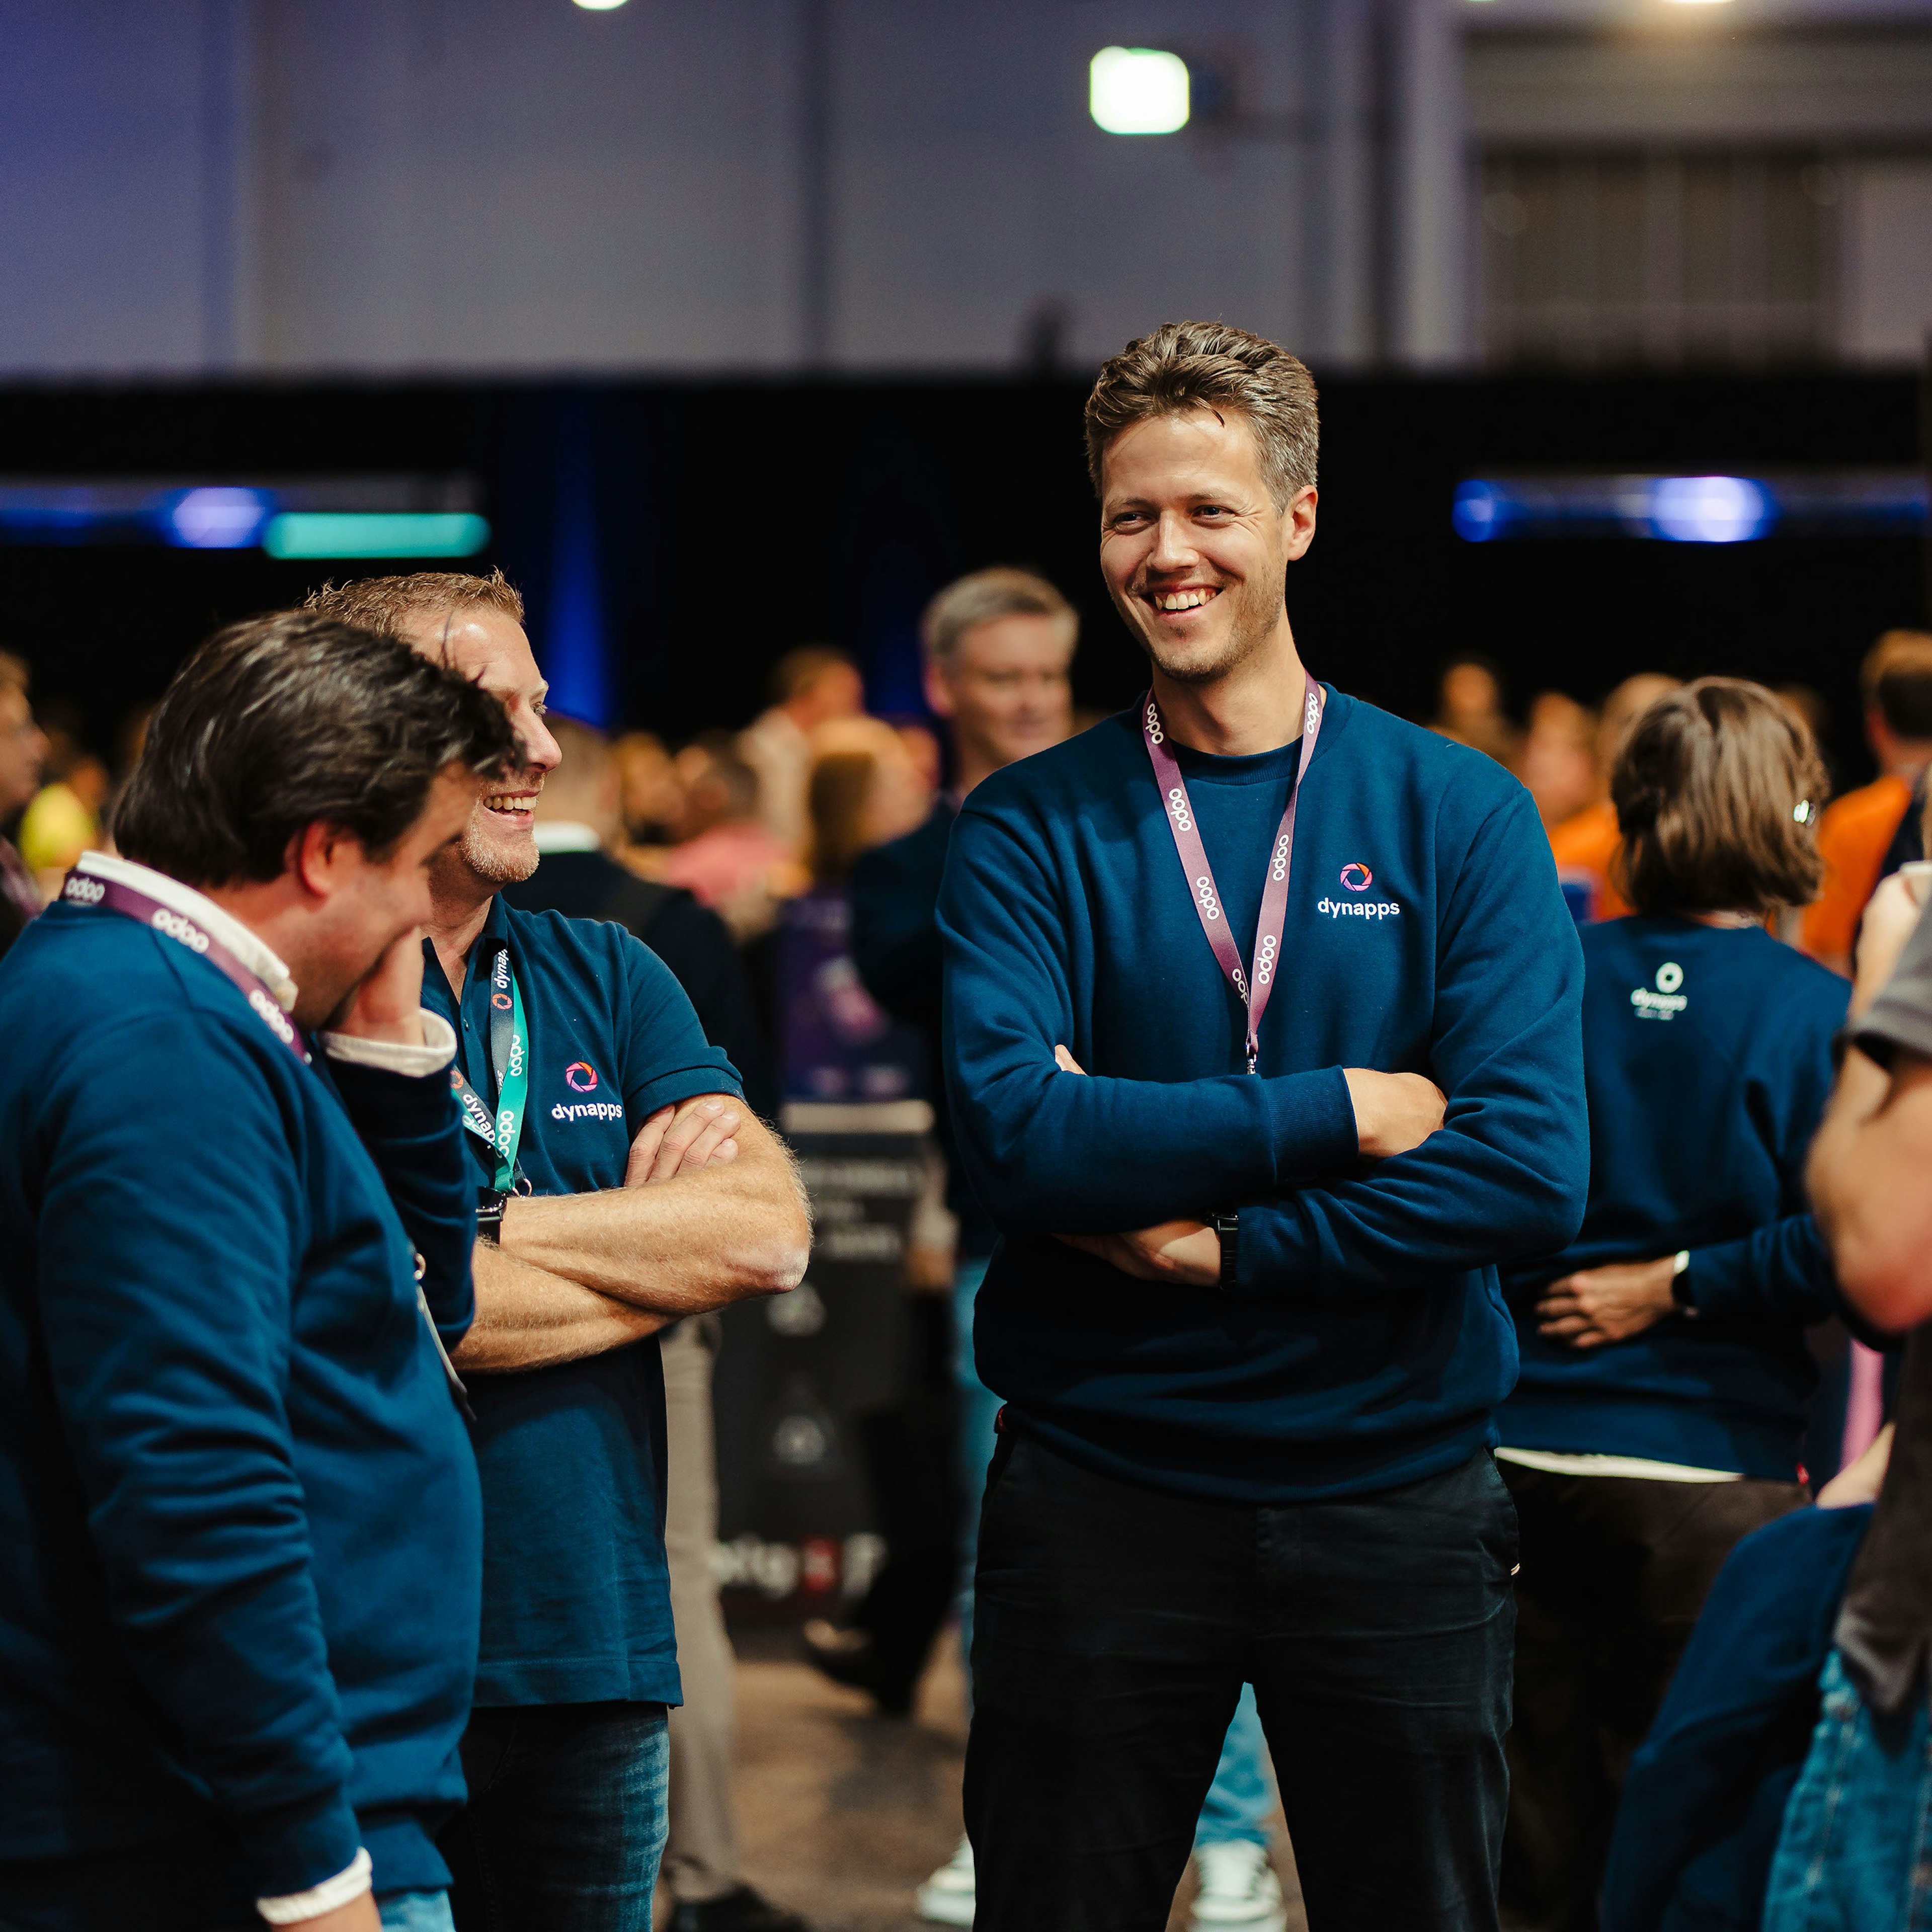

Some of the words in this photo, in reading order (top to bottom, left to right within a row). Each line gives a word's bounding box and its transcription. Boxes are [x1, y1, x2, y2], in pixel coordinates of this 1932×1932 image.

[1145, 703, 1164, 744] odoo
[1307, 692, 1320, 735] odoo
[1169, 788, 1192, 831] odoo
[1272, 834, 1289, 881] odoo
[65, 877, 105, 903] odoo
[1196, 876, 1220, 920] odoo
[1317, 897, 1400, 920] dynapps
[152, 908, 209, 953] odoo
[494, 949, 511, 989] dynap
[1257, 935, 1276, 985] odoo
[1232, 969, 1249, 1005] doo
[249, 990, 294, 1044] odoo
[463, 1094, 495, 1147] dynap
[551, 1103, 622, 1122] dynapps
